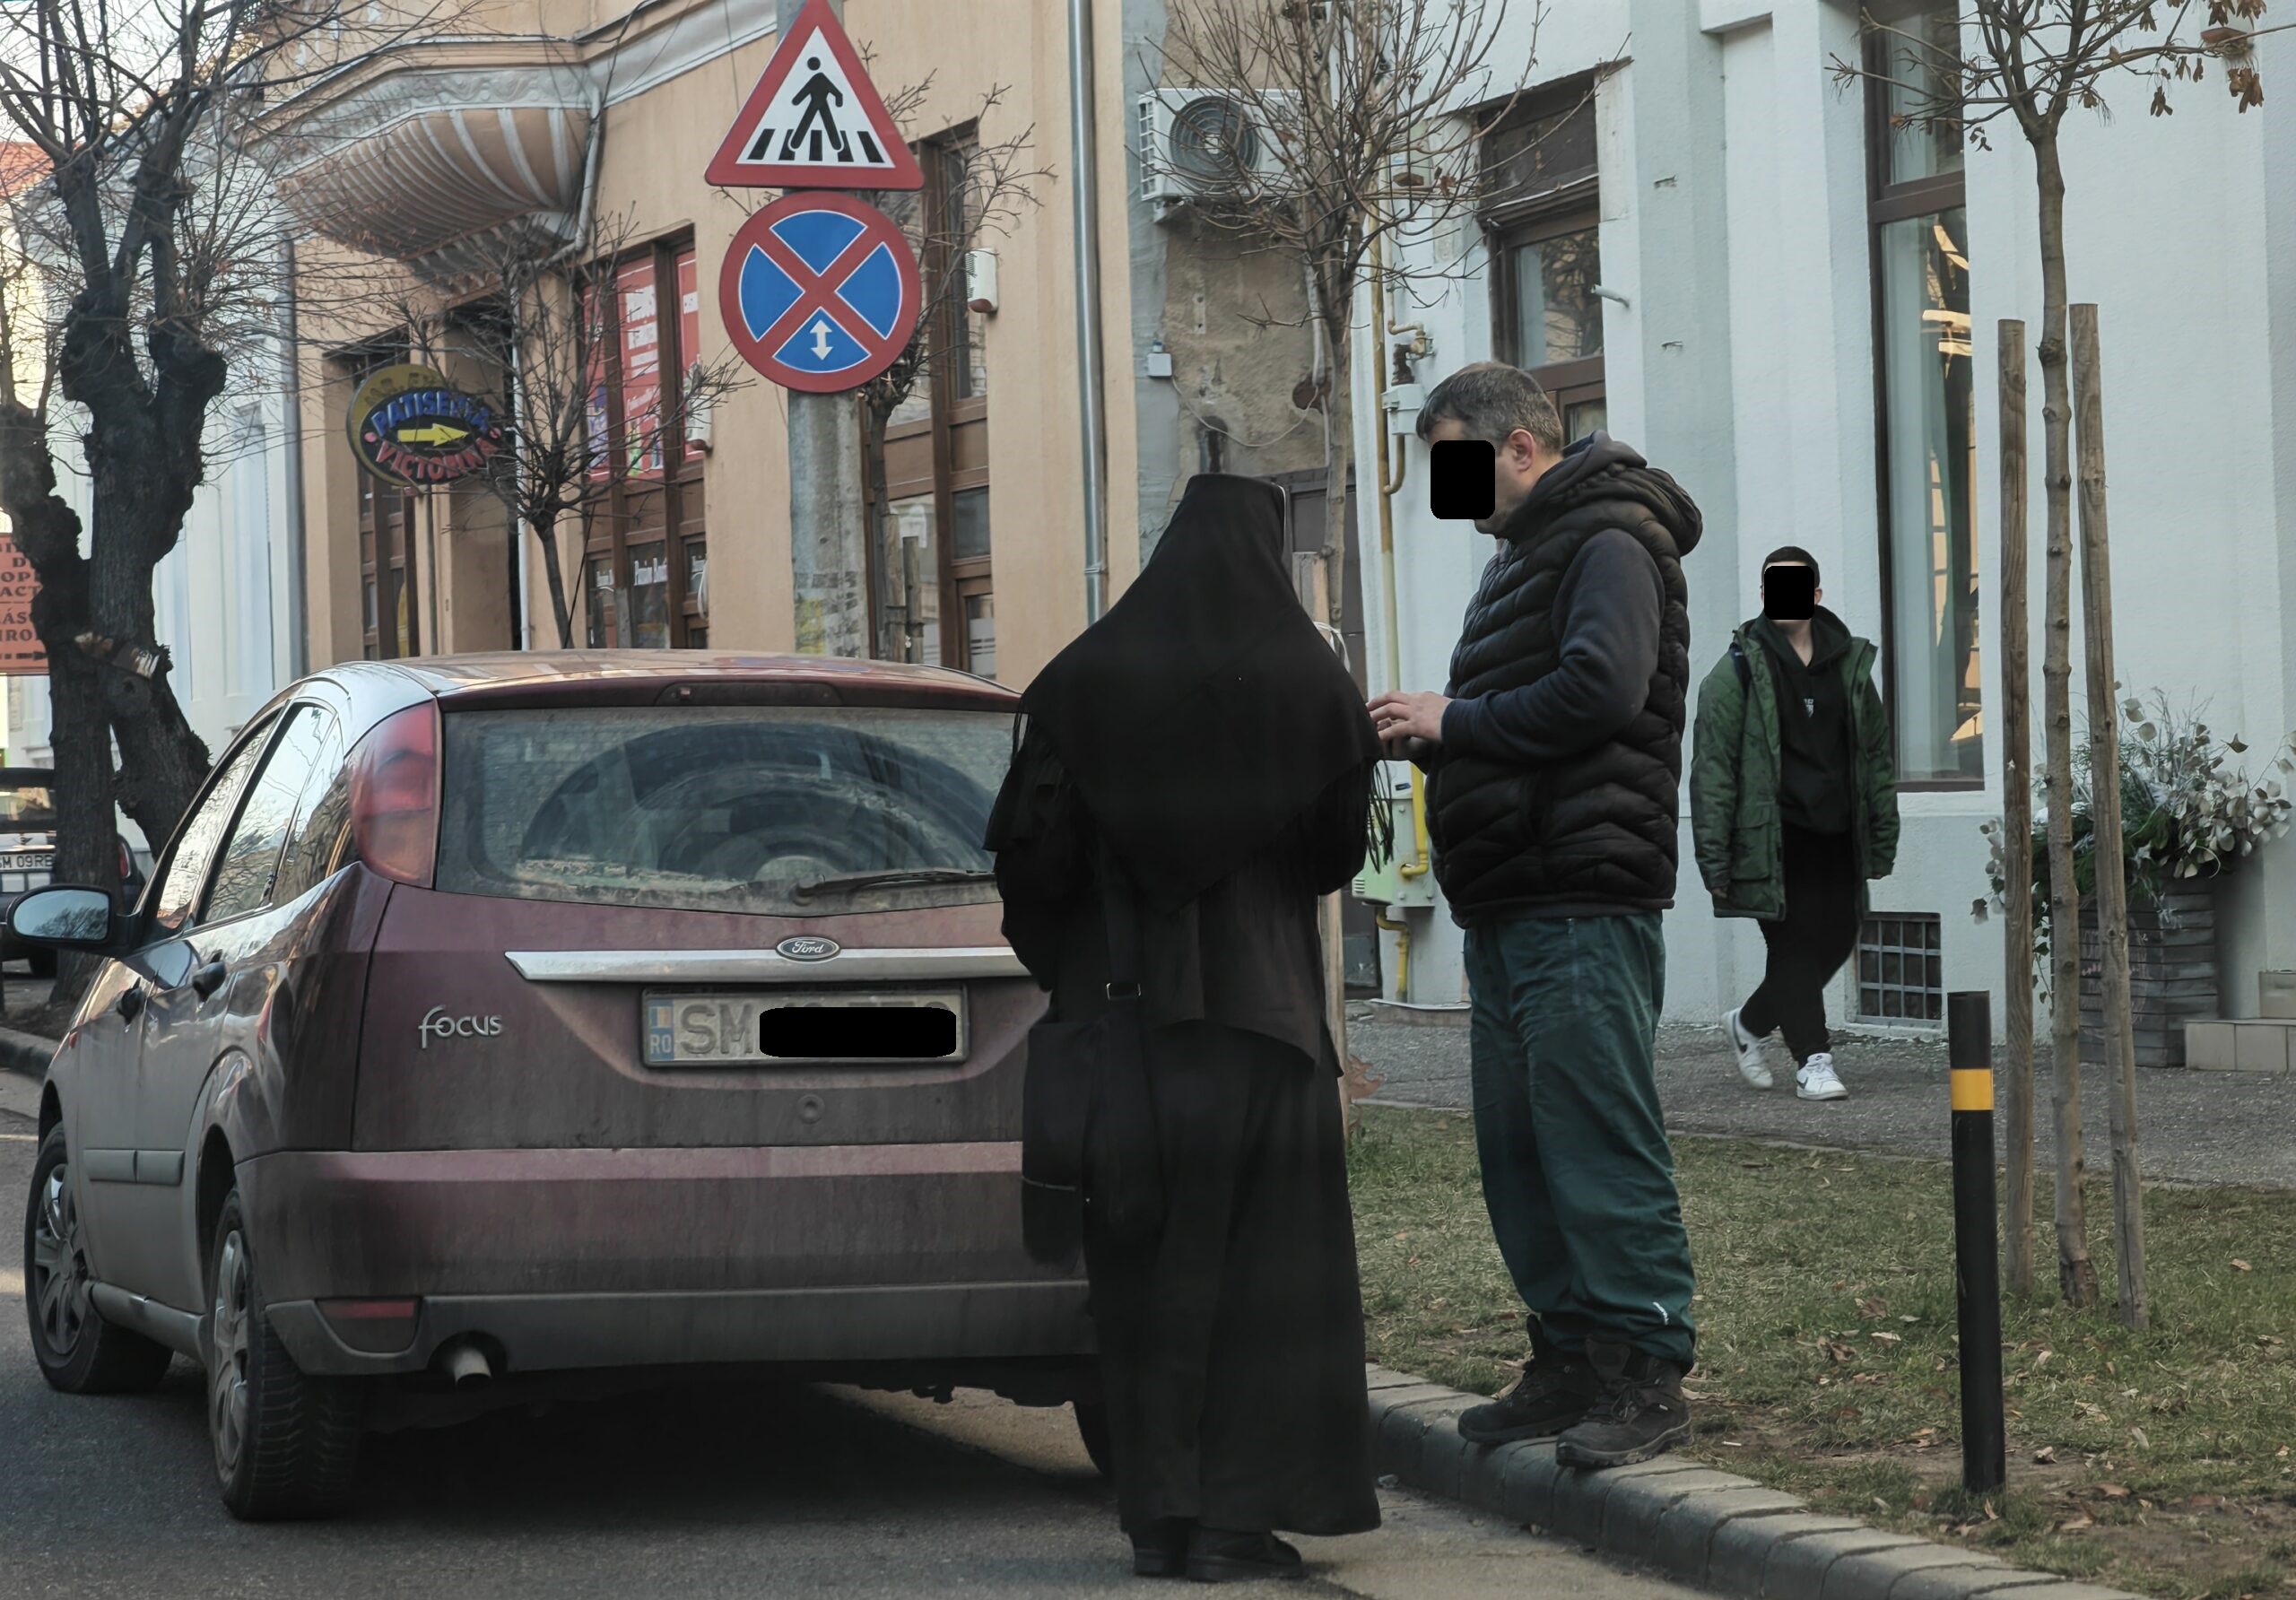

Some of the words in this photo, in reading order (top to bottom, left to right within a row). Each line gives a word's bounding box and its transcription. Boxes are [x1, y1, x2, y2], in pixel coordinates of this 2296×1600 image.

[0, 608, 28, 624] ÁS
[791, 940, 825, 953] Ford
[650, 1034, 673, 1055] RO
[679, 1003, 754, 1056] SM
